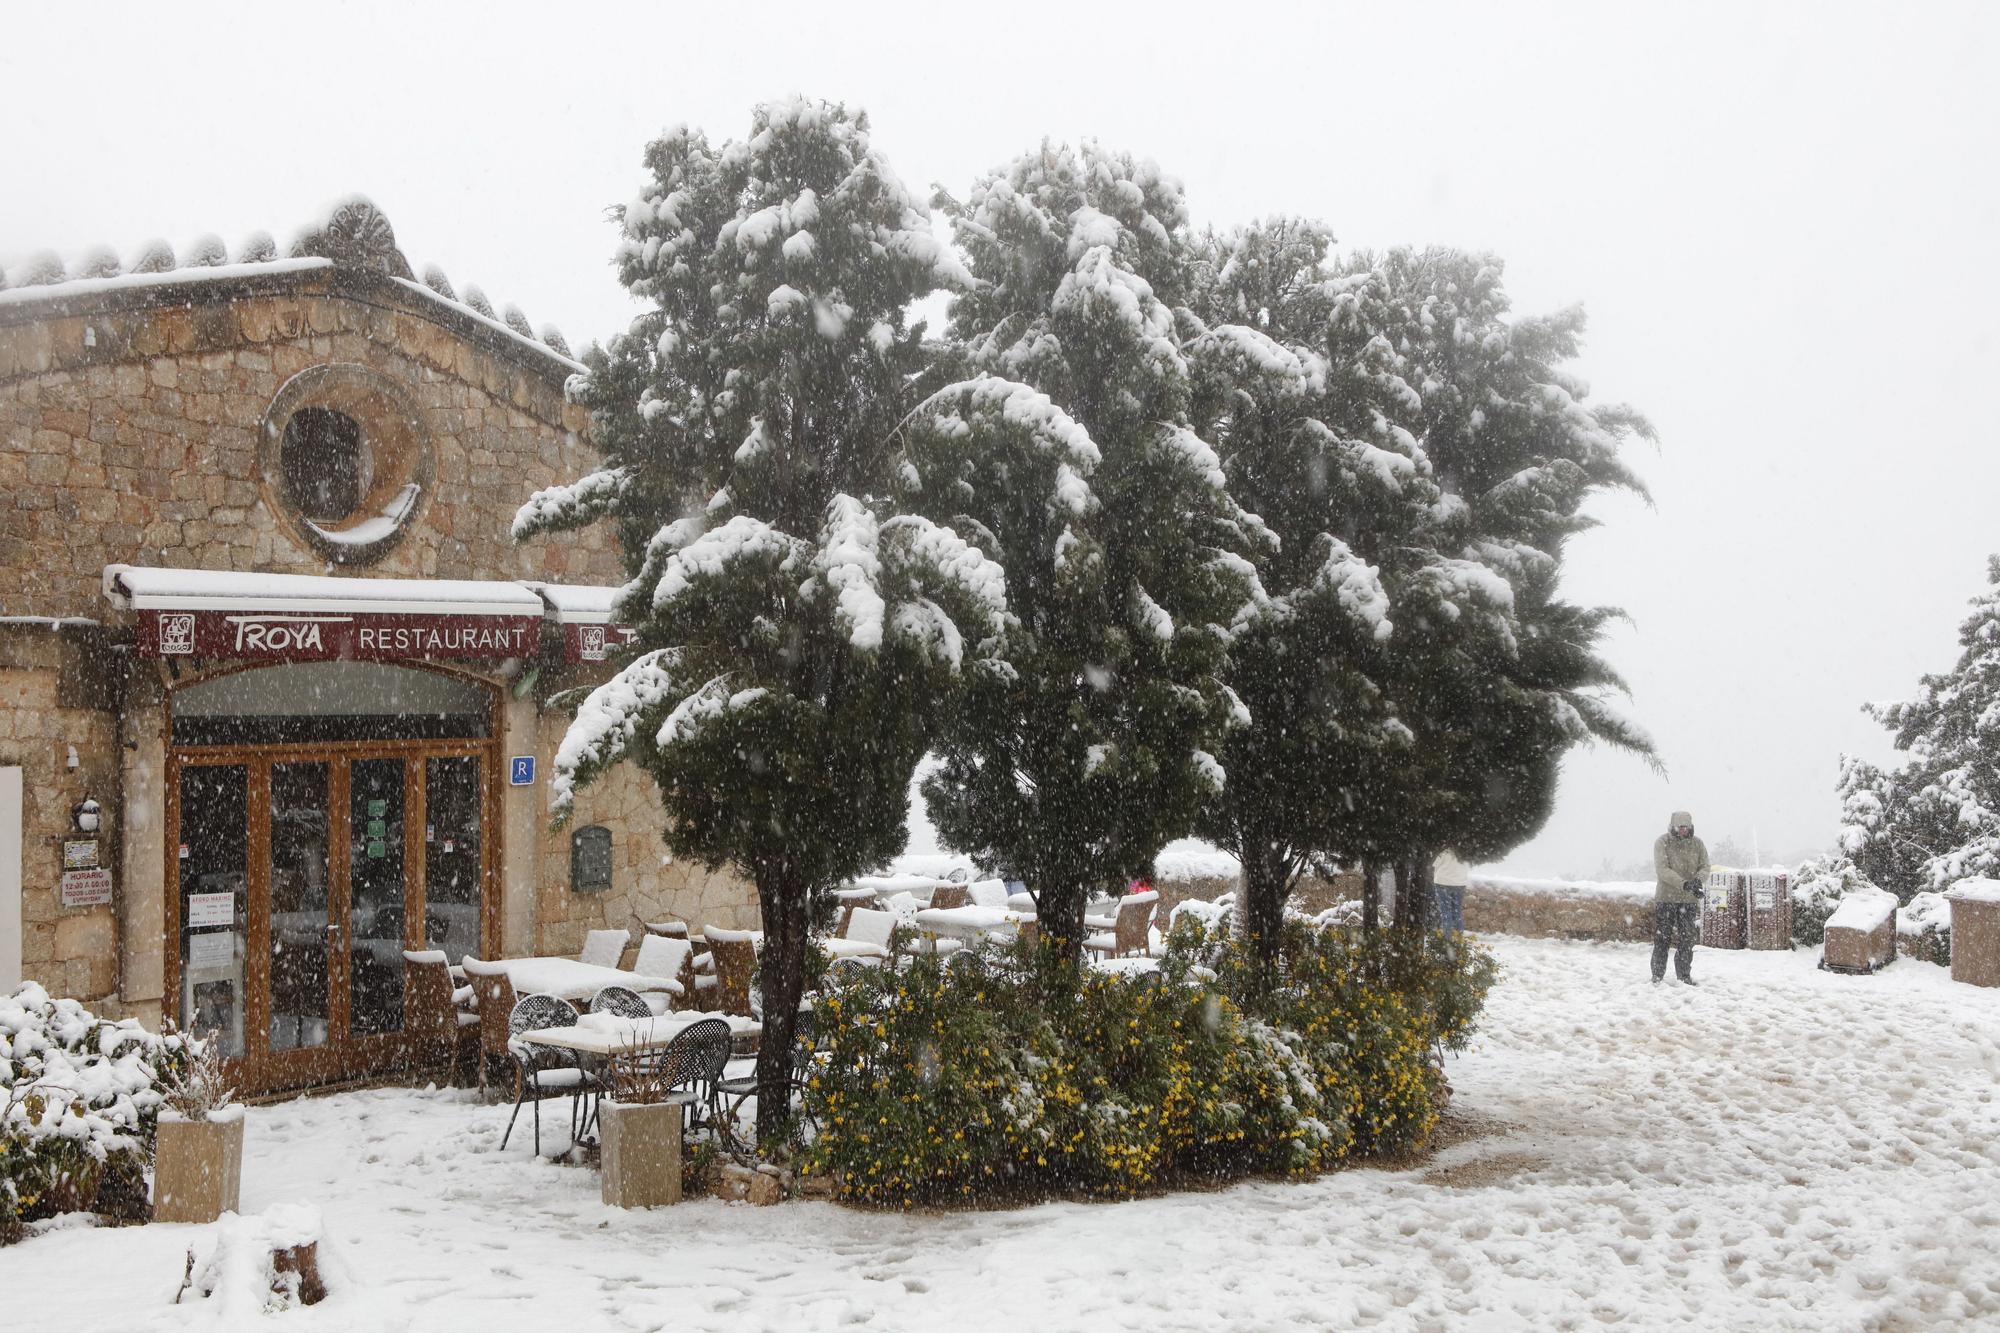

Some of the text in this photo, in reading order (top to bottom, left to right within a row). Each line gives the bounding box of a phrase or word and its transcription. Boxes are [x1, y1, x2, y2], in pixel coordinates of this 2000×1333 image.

[225, 616, 525, 652] TROYA RESTAURANT
[518, 761, 527, 775] R
[71, 872, 103, 880] HORARIO
